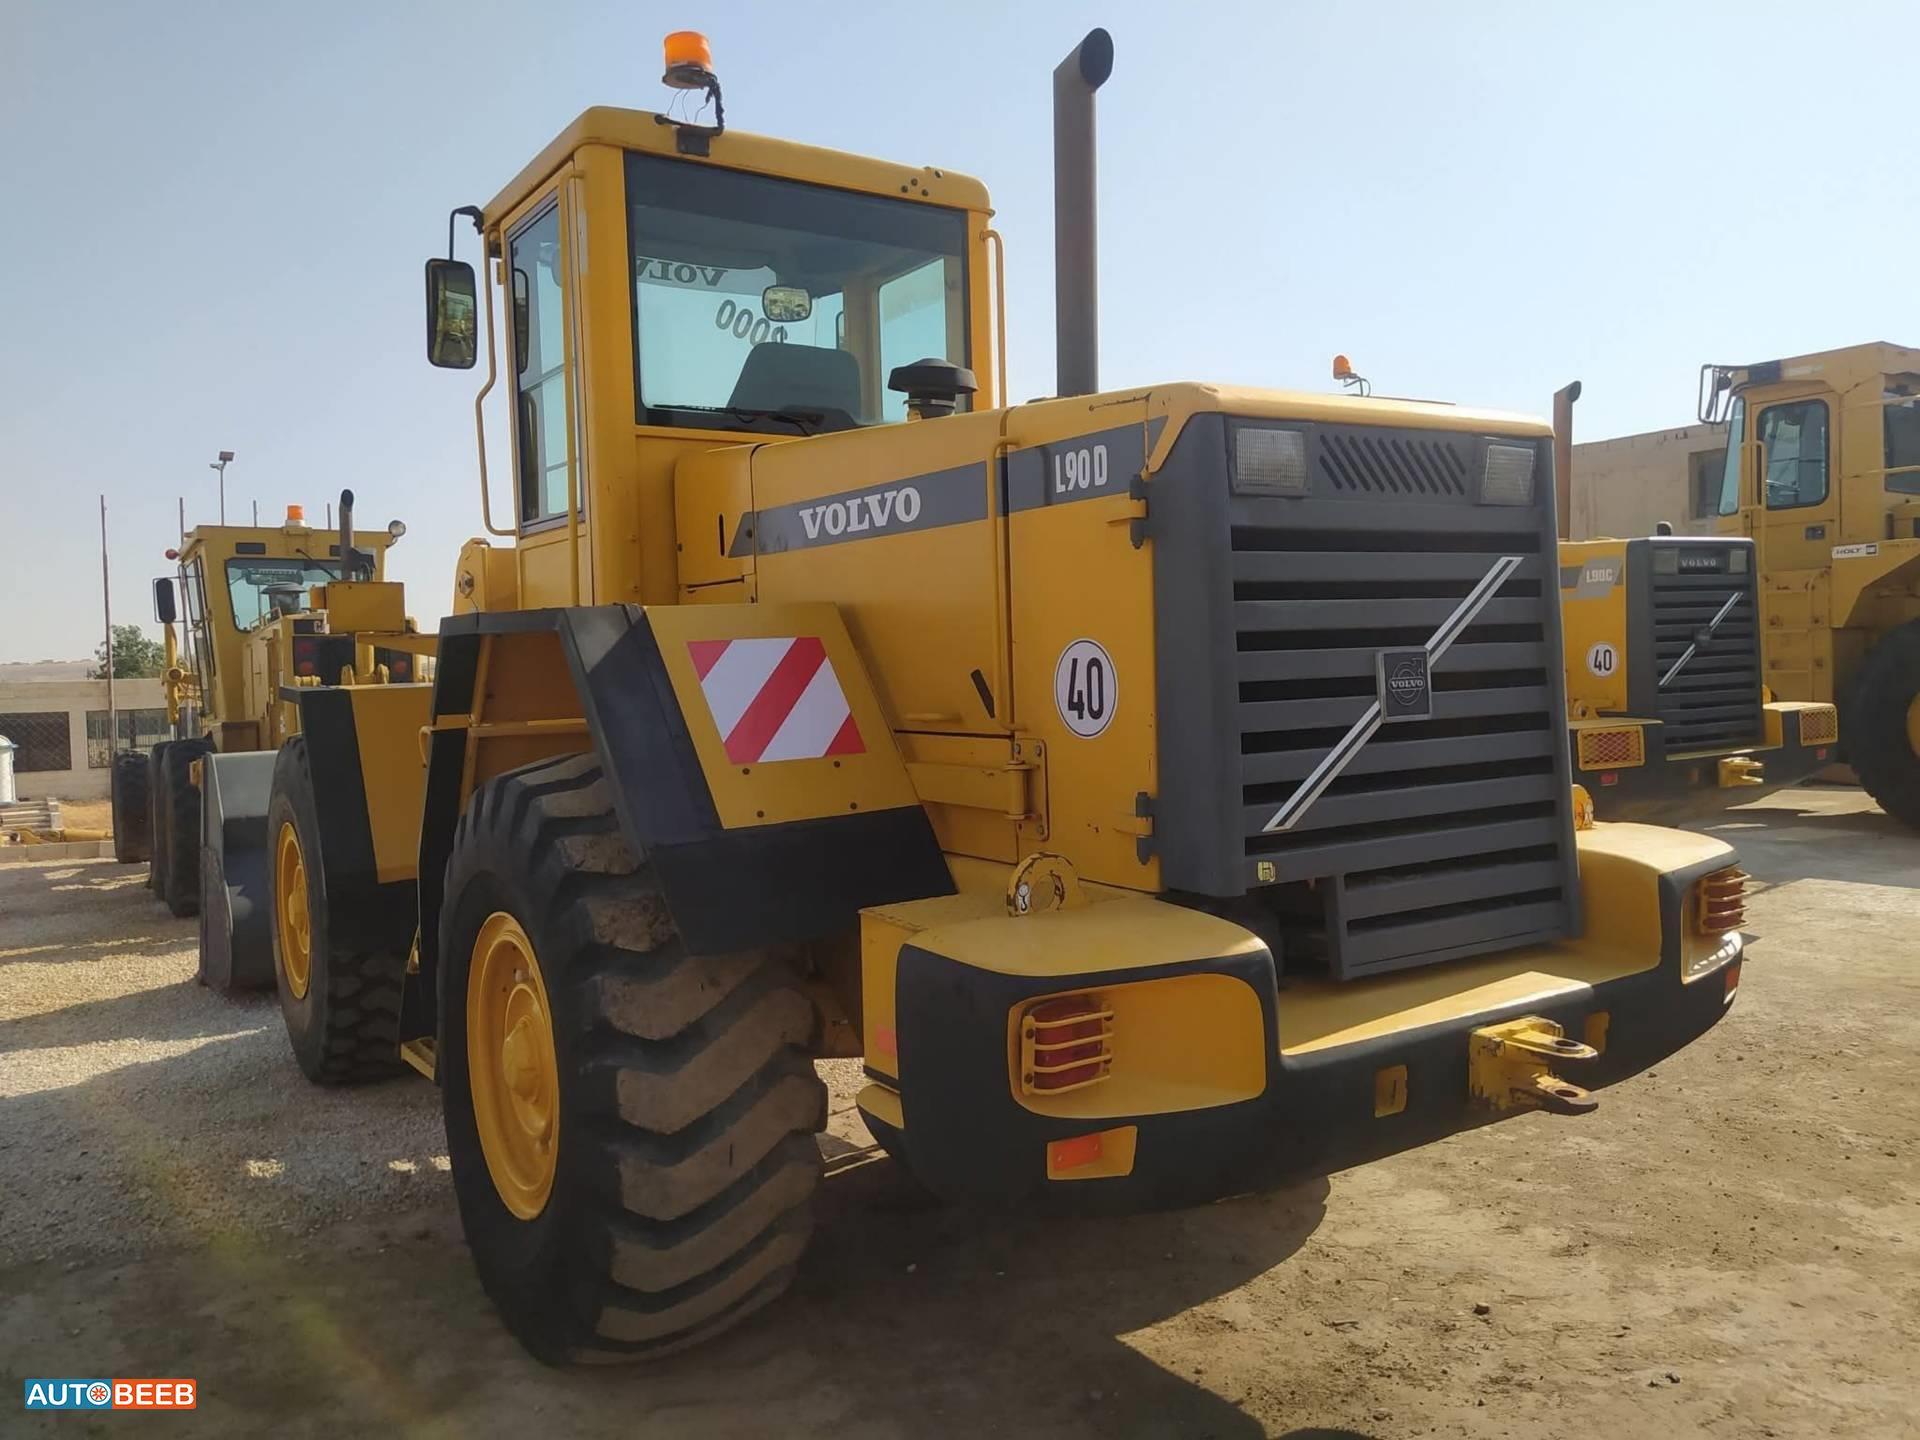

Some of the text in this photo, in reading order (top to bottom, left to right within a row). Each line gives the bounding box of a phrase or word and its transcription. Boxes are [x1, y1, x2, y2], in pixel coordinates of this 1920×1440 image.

[799, 487, 921, 539] VOLVO
[1681, 559, 1717, 568] VOLVO
[1594, 649, 1612, 672] 40
[1068, 657, 1104, 720] 40
[1391, 679, 1424, 688] VOLVO
